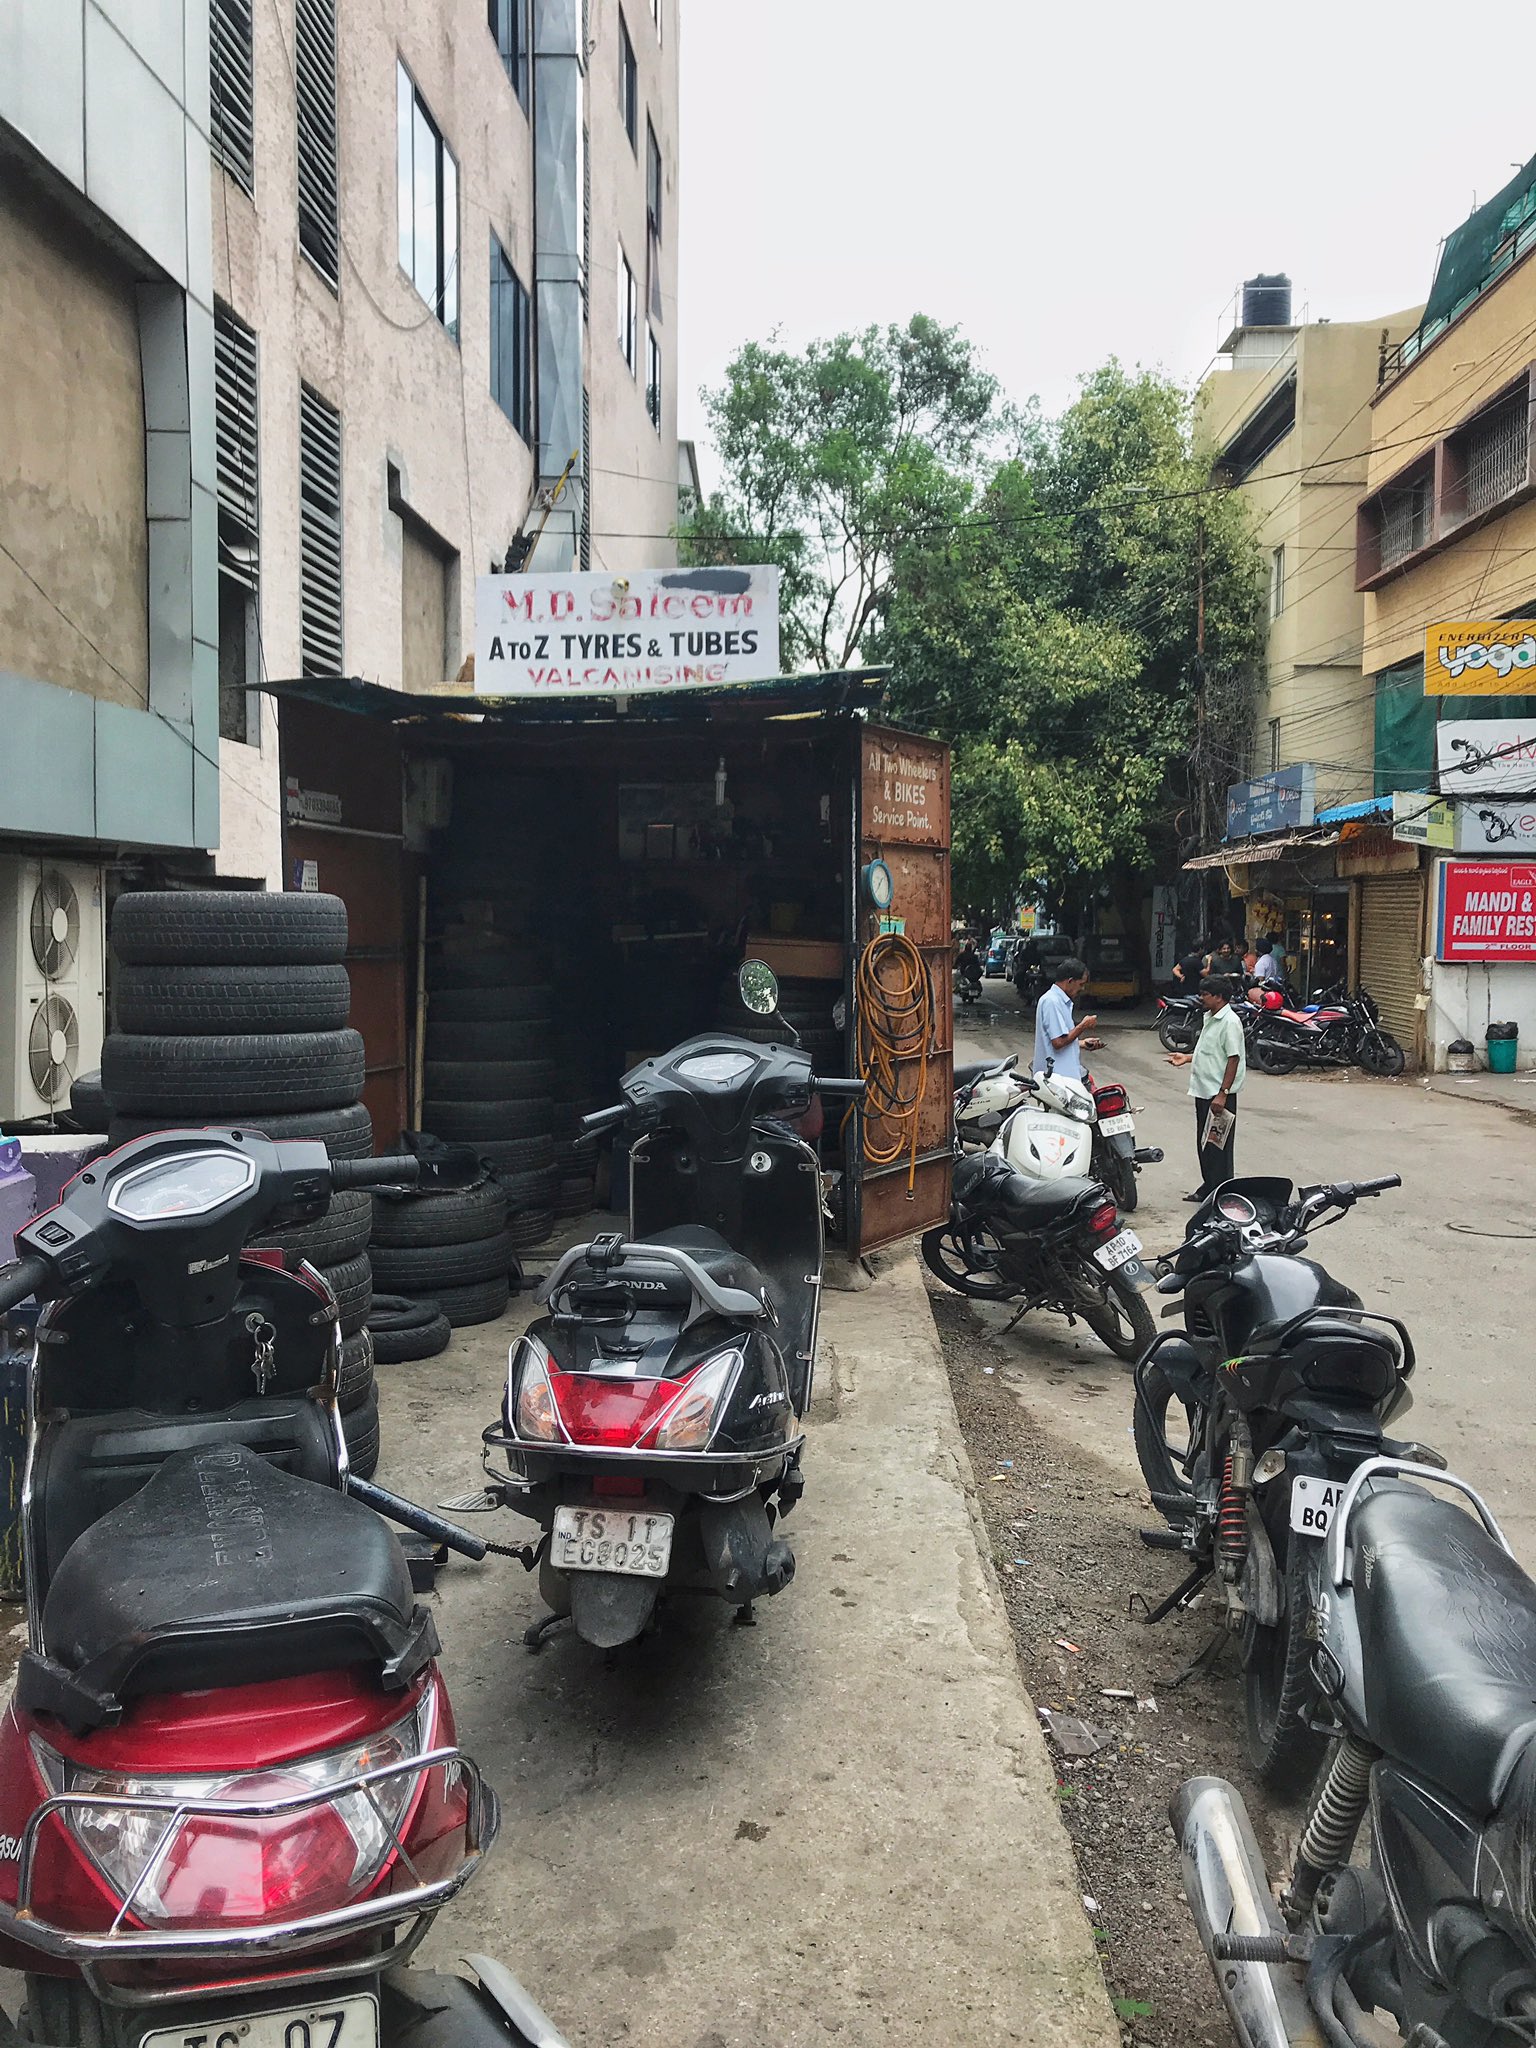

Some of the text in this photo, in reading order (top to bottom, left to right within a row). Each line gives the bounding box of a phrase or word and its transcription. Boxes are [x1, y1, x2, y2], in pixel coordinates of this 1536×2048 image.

[561, 633, 642, 659] TYRES
[647, 639, 663, 657] &
[669, 630, 760, 656] TUBES
[527, 663, 726, 687] VALCANISING
[899, 757, 937, 780] Wheelers
[883, 780, 926, 806] & BIKES
[872, 805, 905, 827] Service
[1465, 892, 1533, 912] MANDI &
[1452, 915, 1536, 936] FAMILY RES
[573, 1511, 606, 1539] TS
[1302, 1507, 1327, 1532] BQ
[558, 1531, 572, 1540] IND
